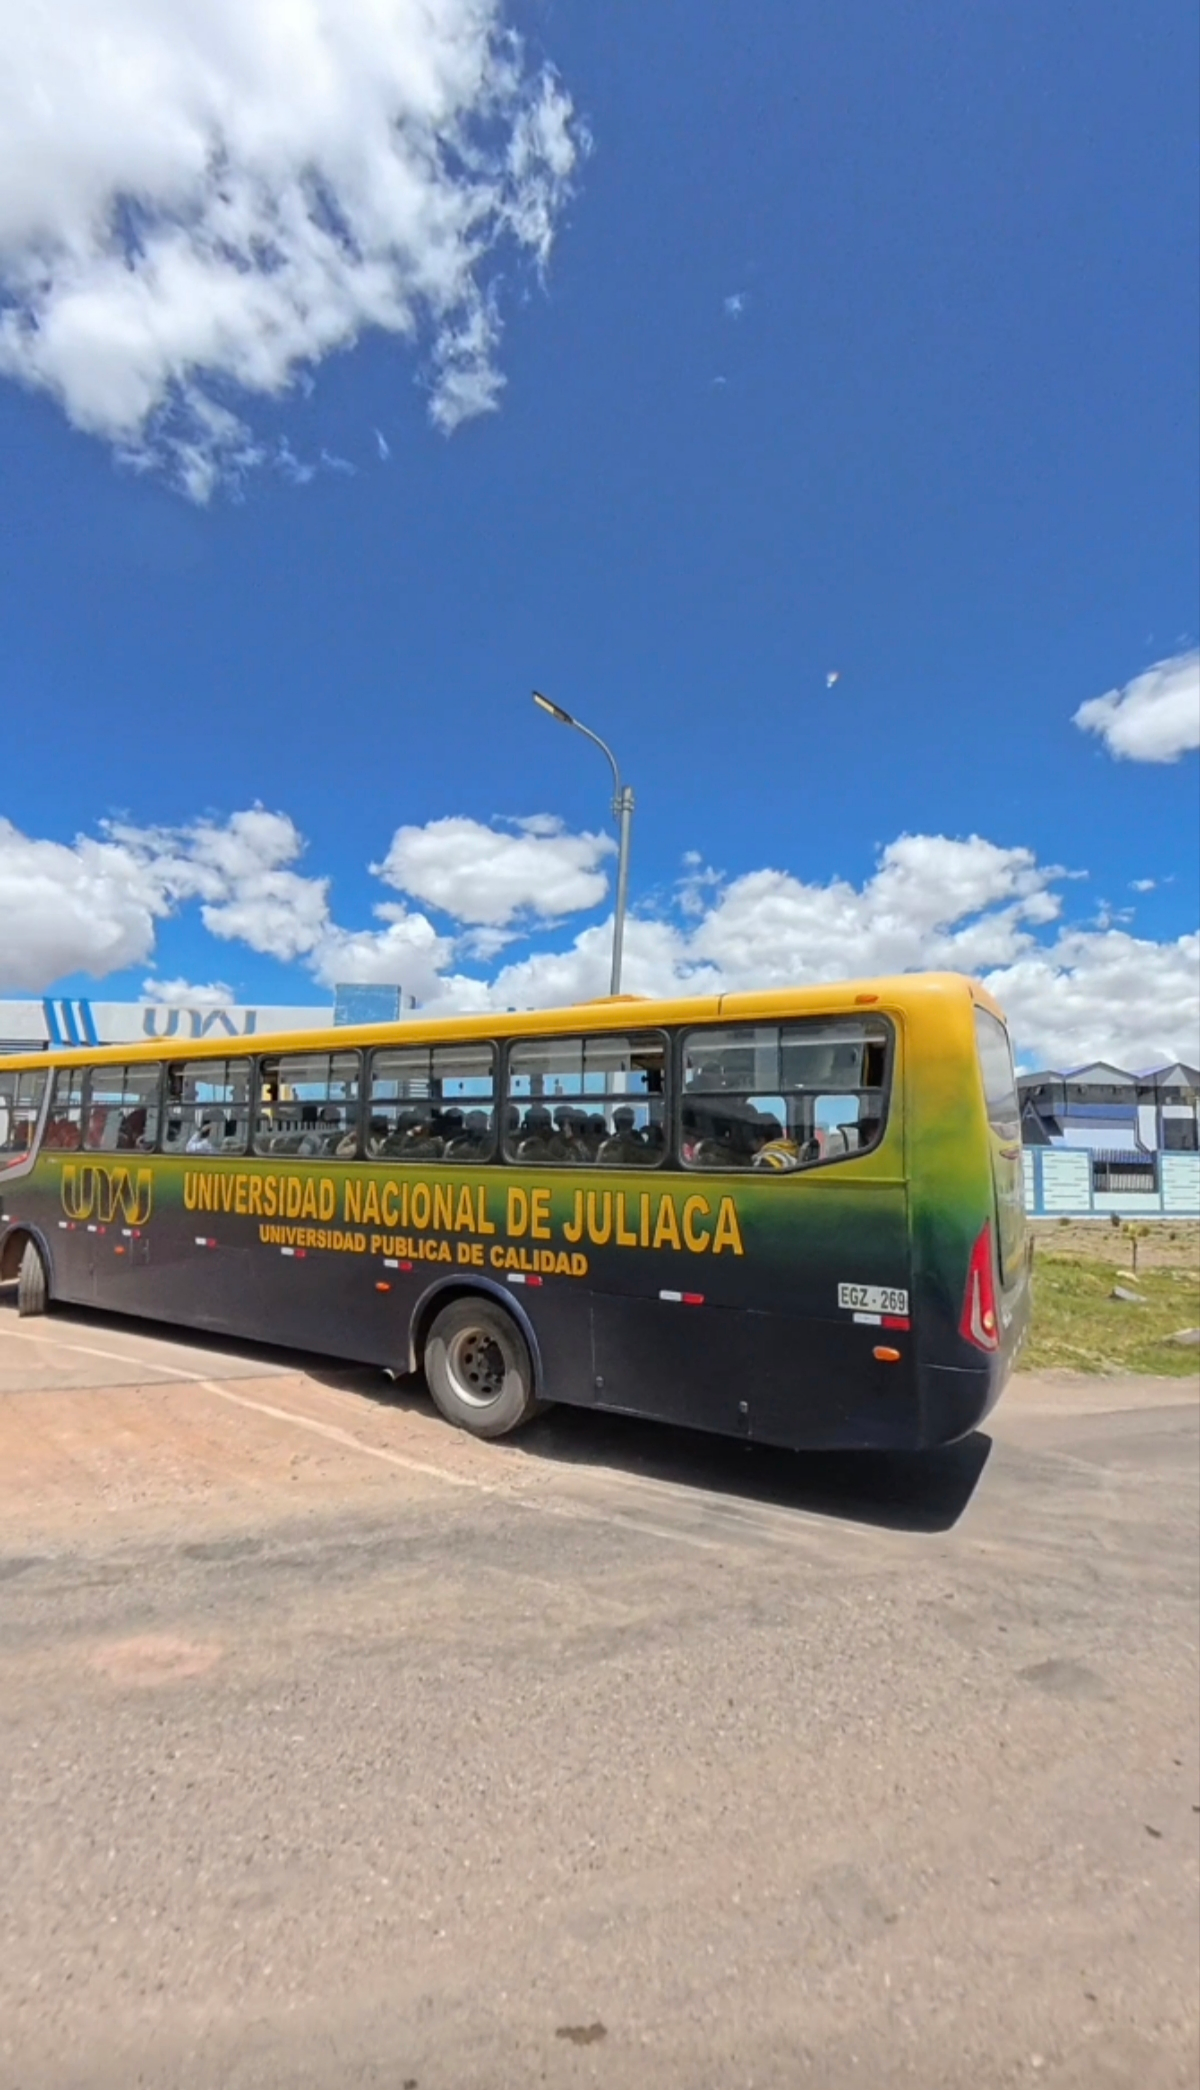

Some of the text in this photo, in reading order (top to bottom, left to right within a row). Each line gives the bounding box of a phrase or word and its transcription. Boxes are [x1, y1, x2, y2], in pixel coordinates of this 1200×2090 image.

[184, 1171, 744, 1255] UNIVERSIDAD NACIONAL DE JULIACA
[259, 1224, 588, 1276] UNIVERSIDAD PUBLICA DE CALIDAD
